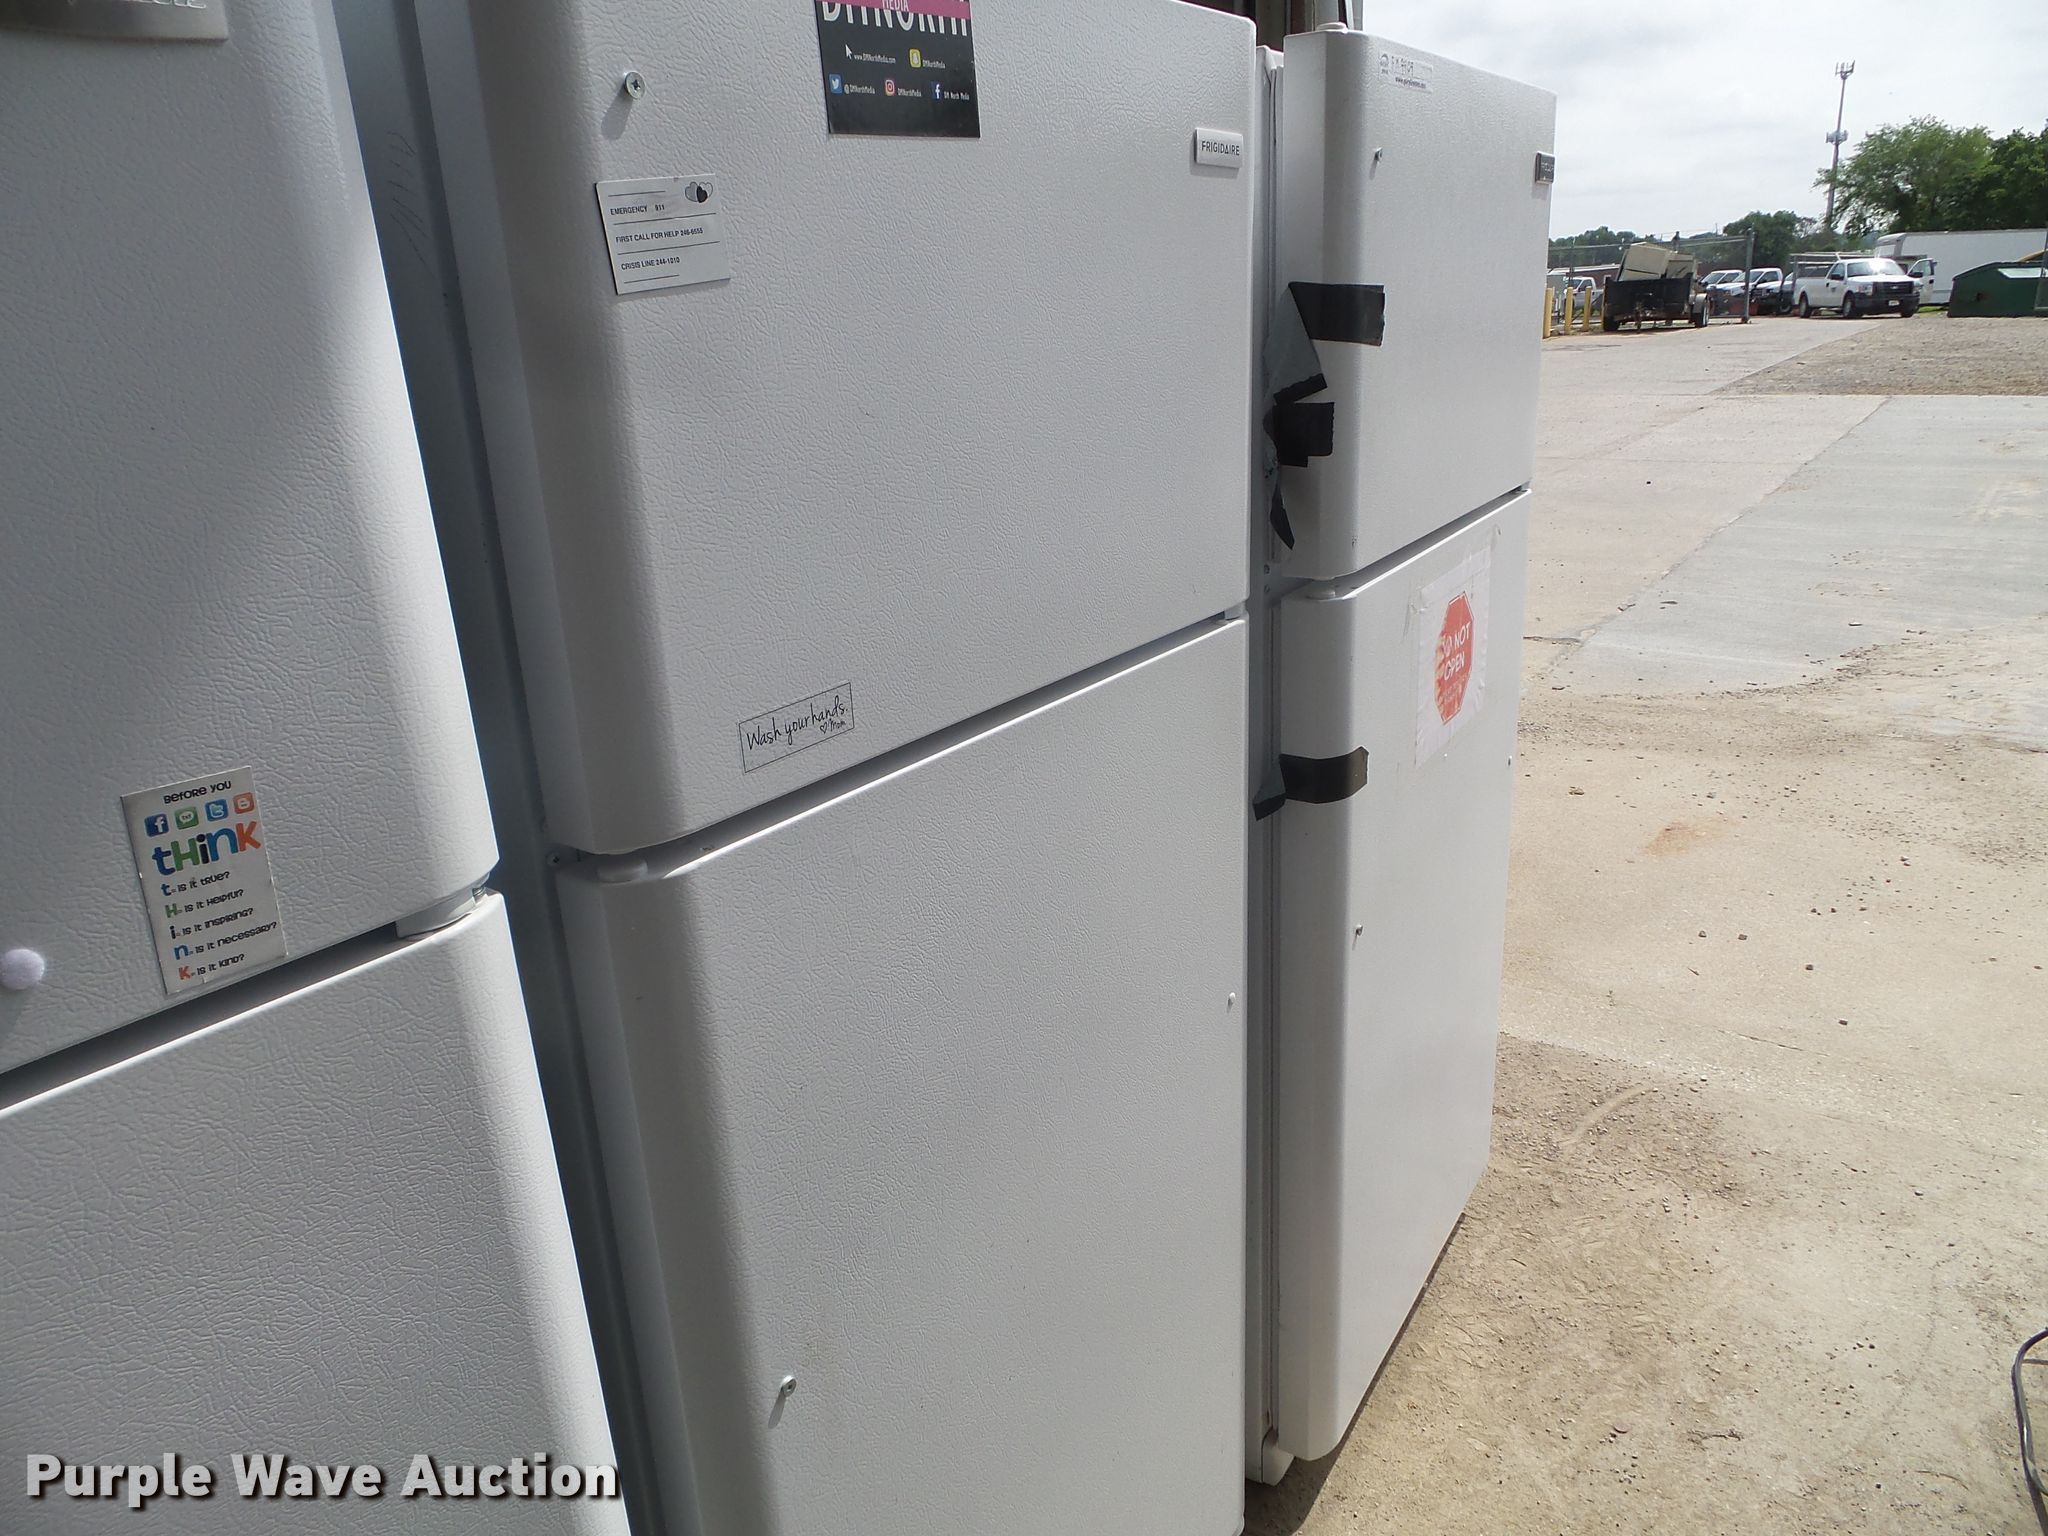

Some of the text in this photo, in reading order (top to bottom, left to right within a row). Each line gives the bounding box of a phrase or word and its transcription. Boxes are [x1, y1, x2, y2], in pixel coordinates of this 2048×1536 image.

[1201, 140, 1240, 156] FRIGIDAIRE
[610, 204, 665, 216] EMERGENCY 911
[615, 234, 633, 243] FIRST
[634, 233, 650, 241] CALL
[651, 232, 664, 240] FOR
[664, 230, 680, 238] HELP
[621, 262, 640, 270] CRISIS
[641, 260, 655, 268] LINE
[1454, 621, 1471, 650] NOT
[1444, 651, 1465, 681] OPEN
[746, 716, 782, 751] Wash
[785, 715, 810, 745] your
